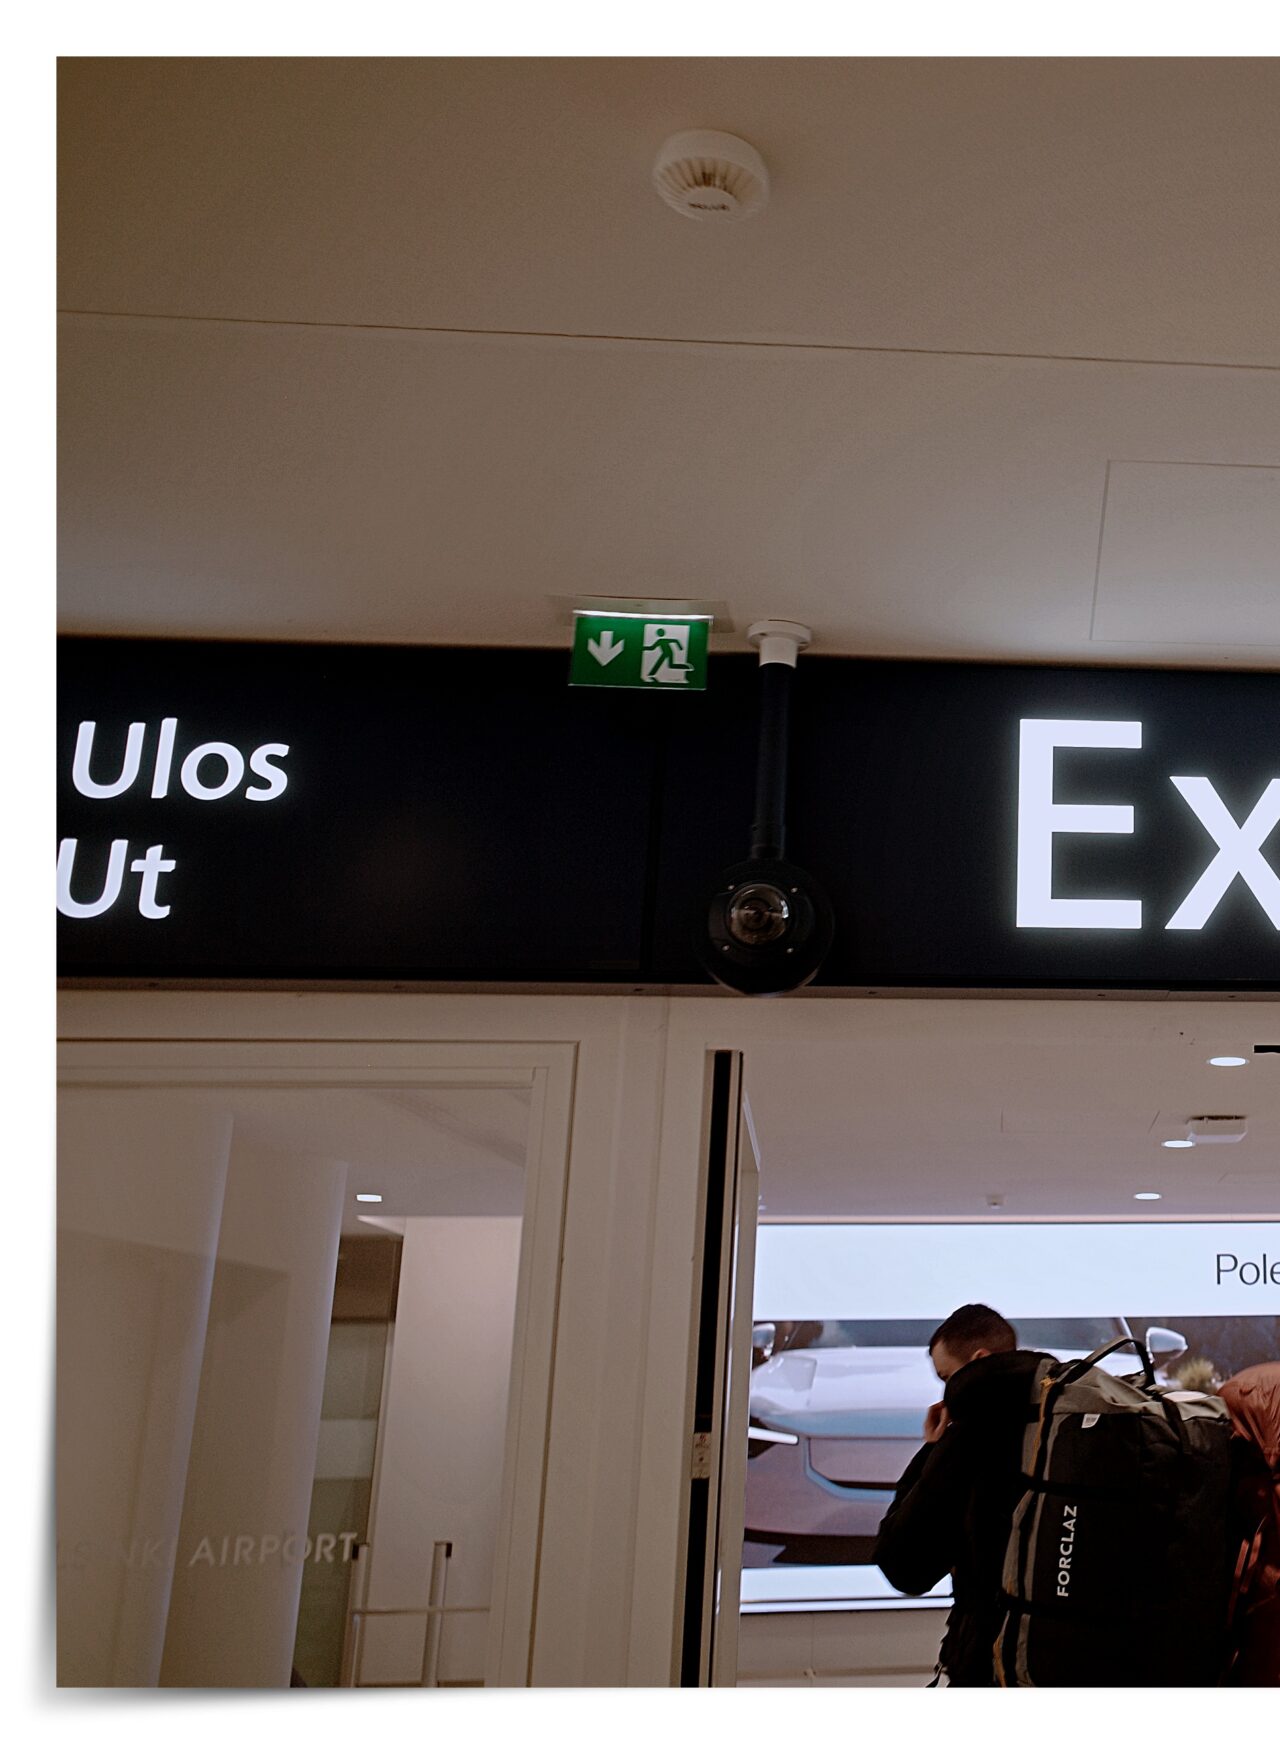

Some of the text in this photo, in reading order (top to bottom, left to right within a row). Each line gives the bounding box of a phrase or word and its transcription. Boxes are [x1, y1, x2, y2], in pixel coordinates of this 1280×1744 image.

[72, 717, 290, 802] Ulos
[56, 837, 177, 920] Ut
[188, 1531, 358, 1568] AIRPORT
[1056, 1504, 1078, 1598] FORCLAZ
